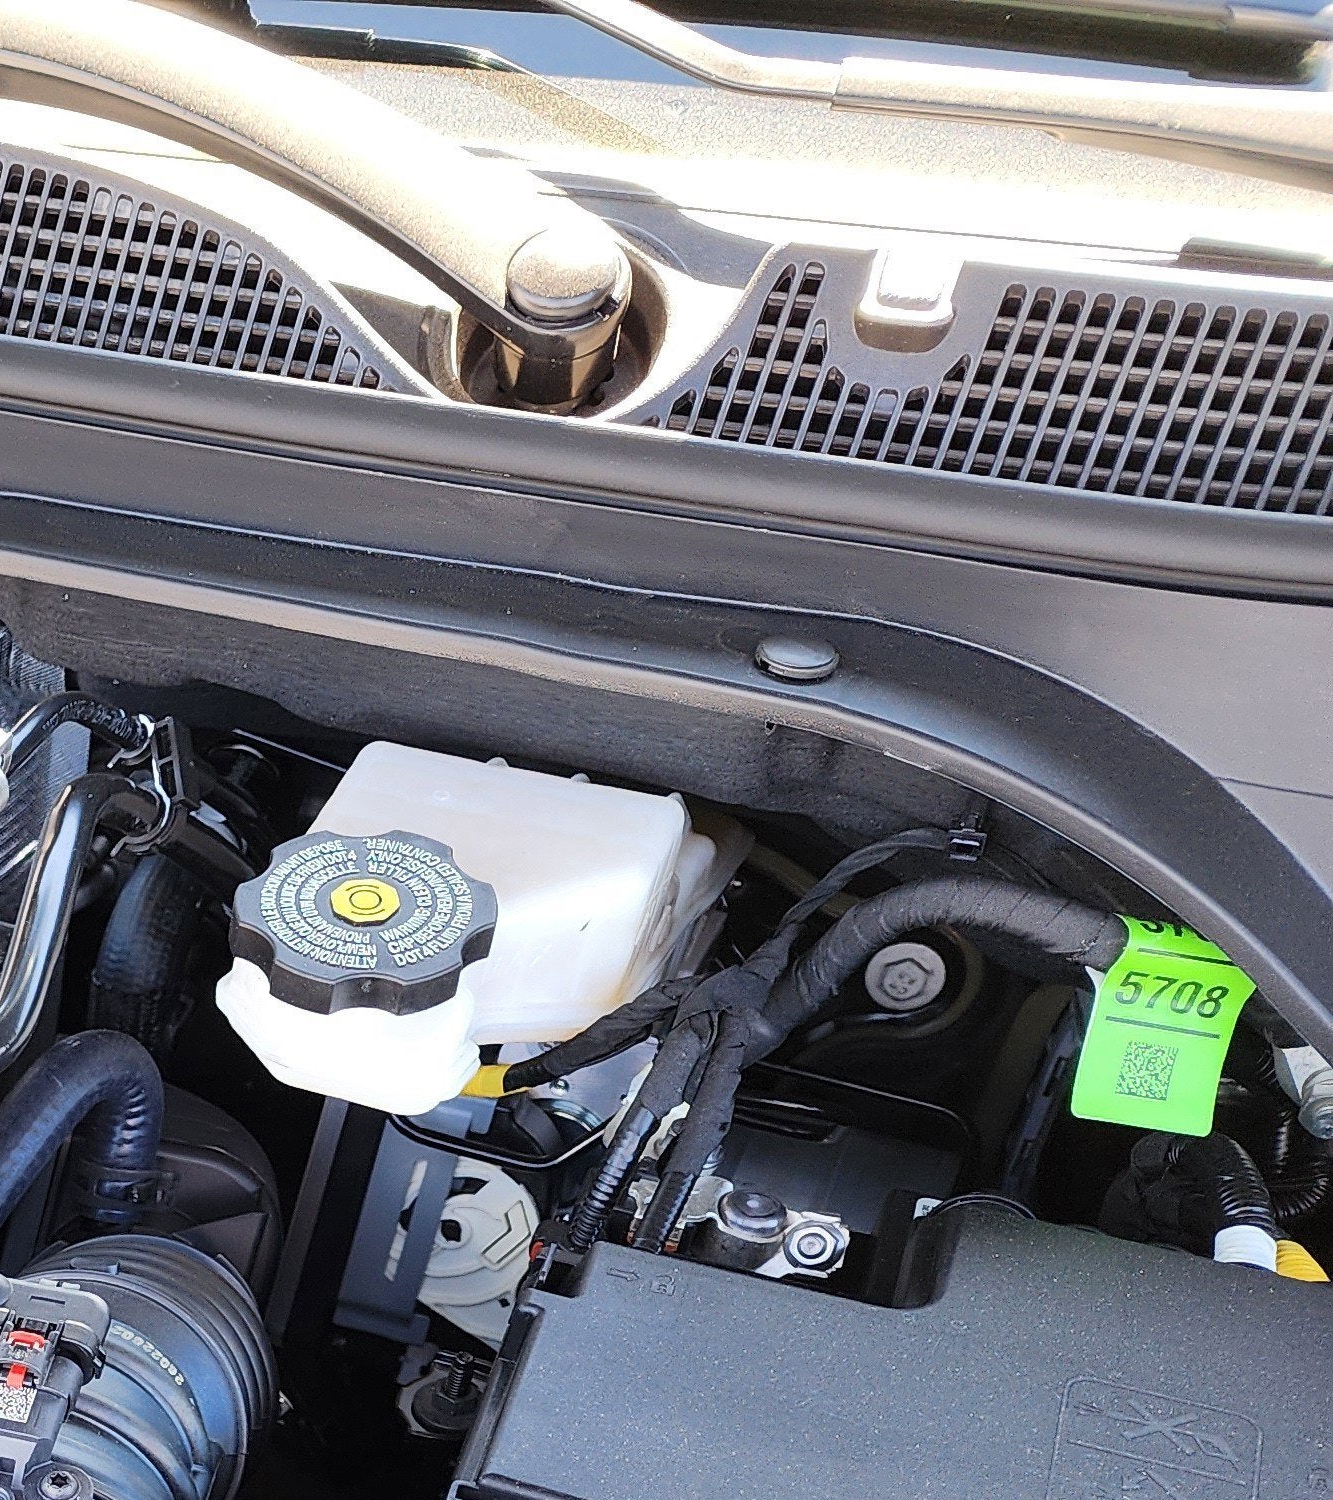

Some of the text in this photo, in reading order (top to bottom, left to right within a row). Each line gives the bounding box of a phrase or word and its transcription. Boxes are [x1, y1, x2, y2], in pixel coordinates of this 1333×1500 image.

[365, 849, 405, 865] ONLY
[366, 861, 416, 883] FILLER
[432, 860, 471, 895] SEALED
[402, 875, 434, 906] CLEAN
[260, 908, 282, 920] LE
[409, 911, 451, 945] BEFORE
[425, 926, 464, 953] FLUID
[385, 935, 420, 954] CAP
[1114, 970, 1230, 1019] 5708
